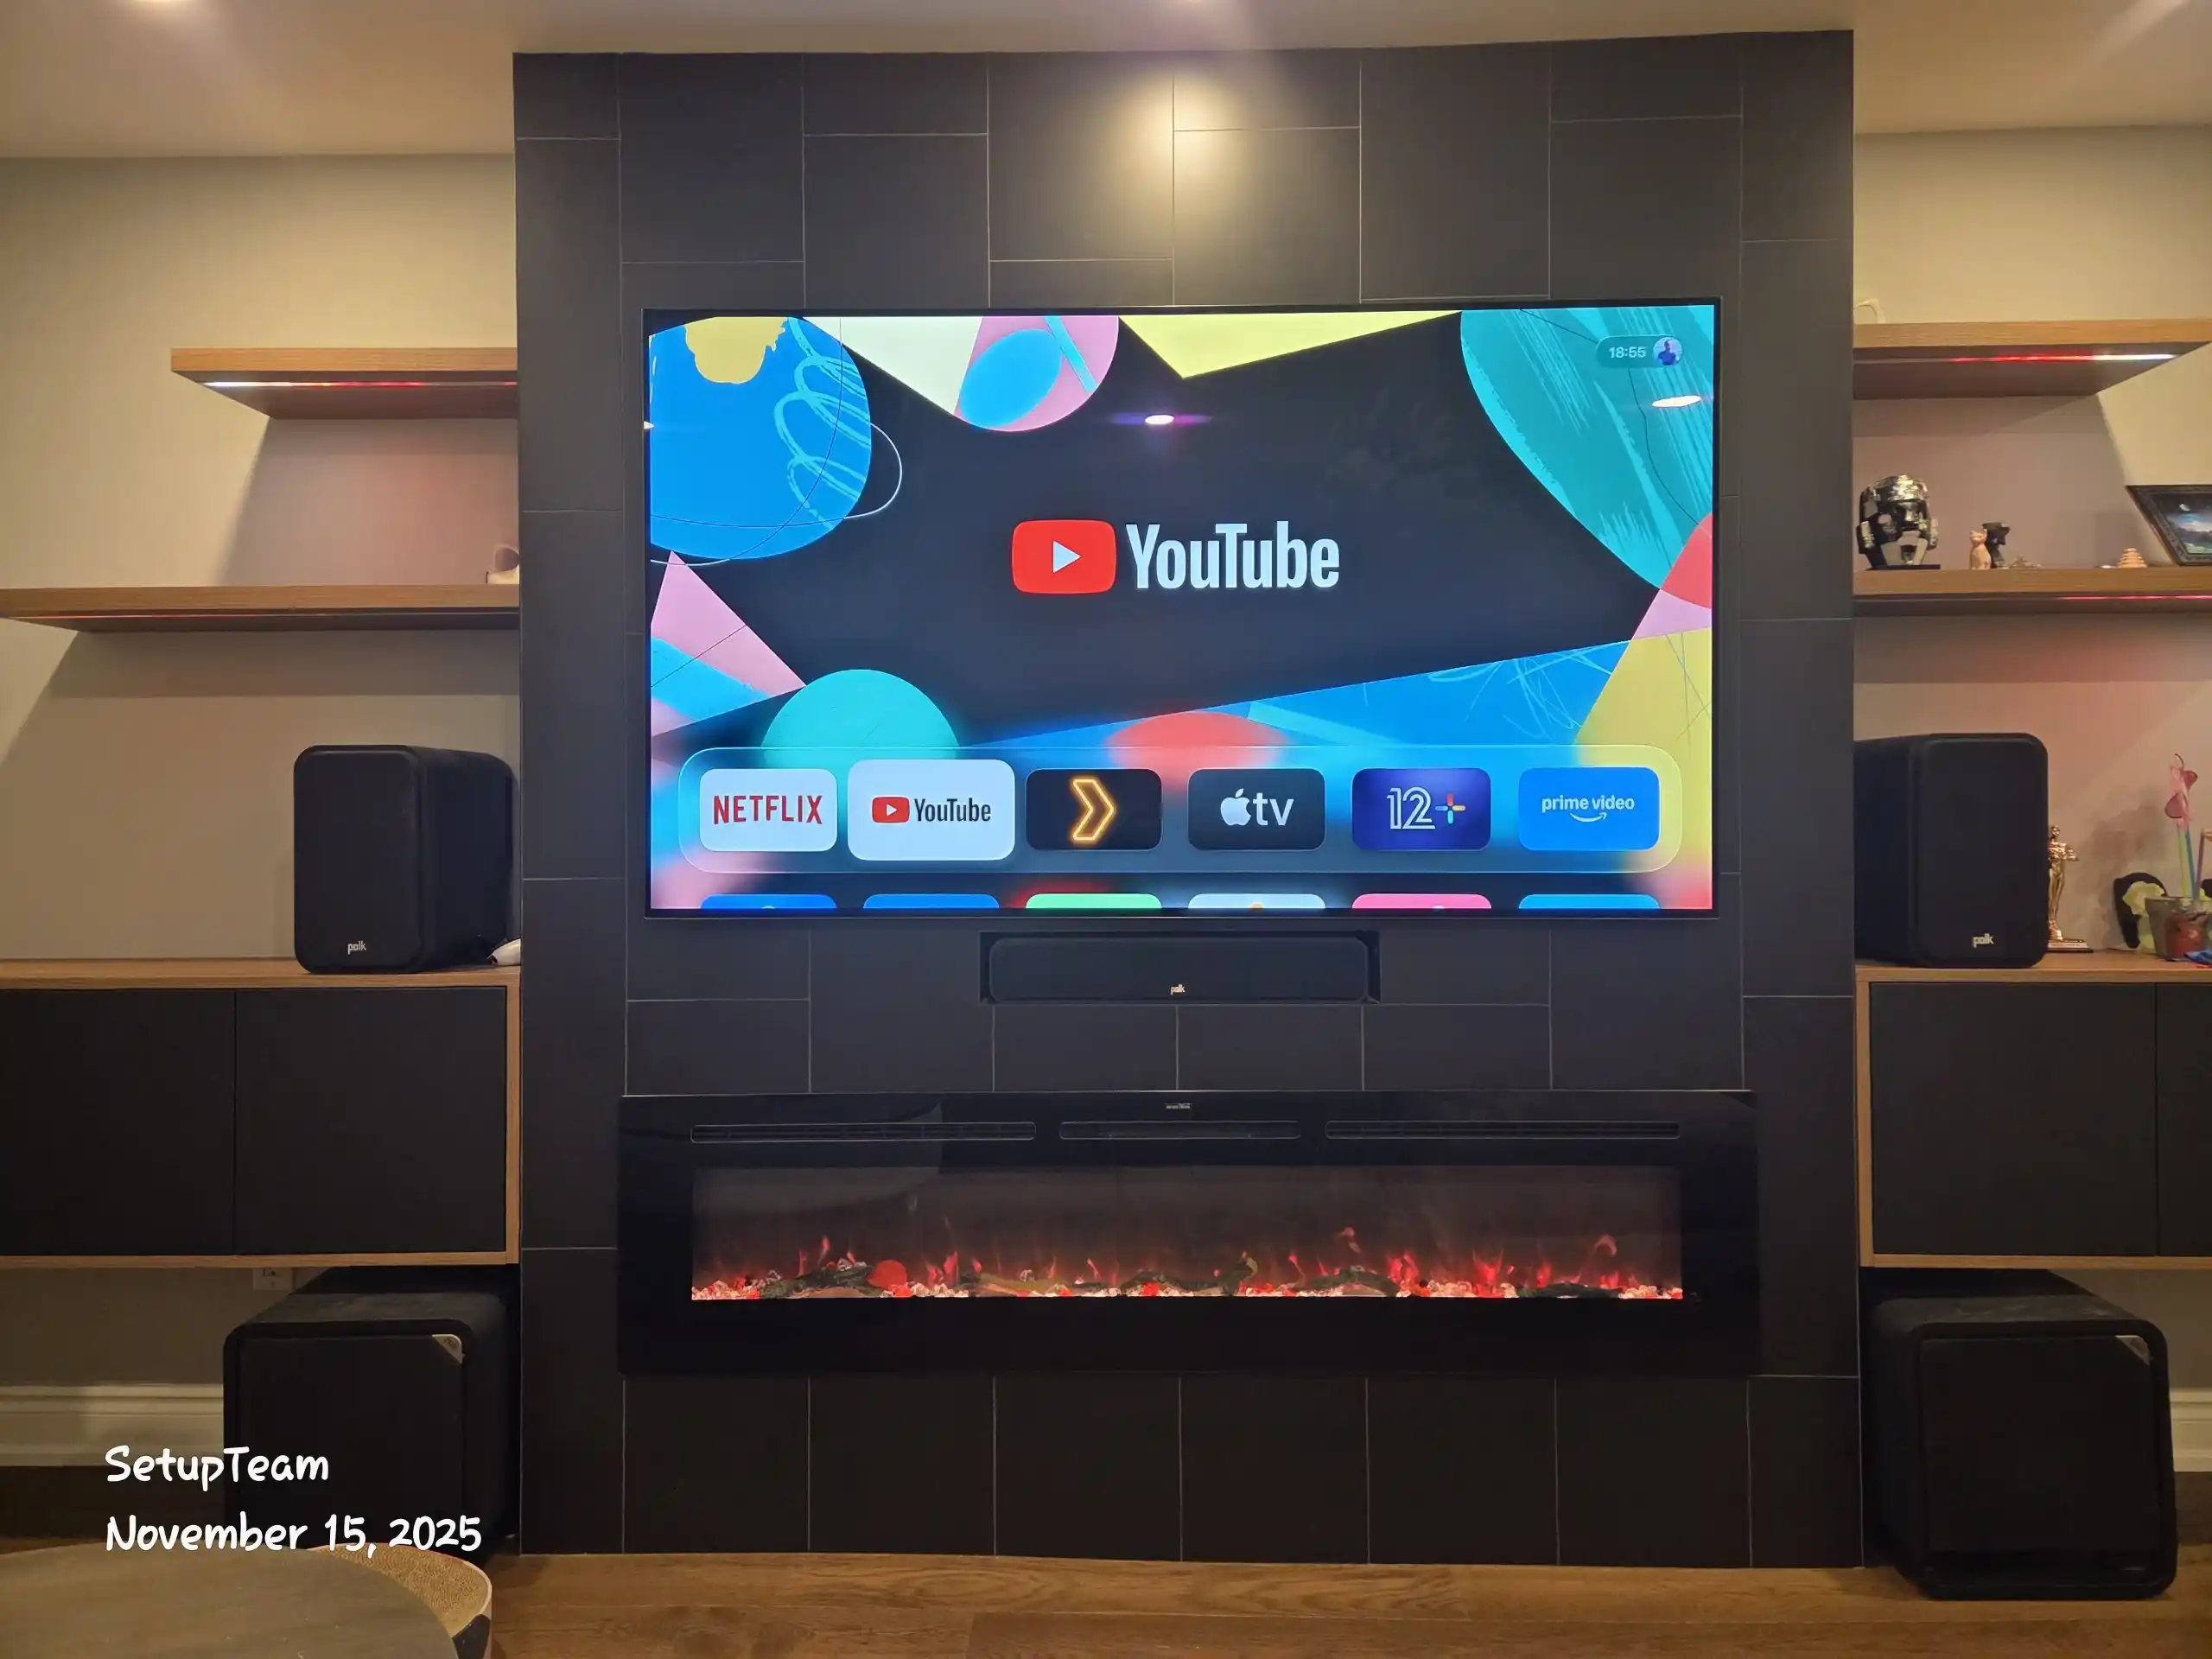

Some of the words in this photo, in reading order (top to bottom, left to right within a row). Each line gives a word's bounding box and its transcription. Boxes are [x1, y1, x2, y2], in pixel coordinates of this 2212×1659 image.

[1609, 346, 1646, 359] 18:55
[1125, 520, 1340, 589] YouTube
[713, 795, 823, 824] NETFLIX
[914, 796, 991, 822] YouTube
[1253, 792, 1294, 826] tv
[1541, 795, 1589, 813] prime
[1592, 795, 1635, 810] video
[347, 940, 367, 955] polk
[1973, 933, 1994, 948] polk
